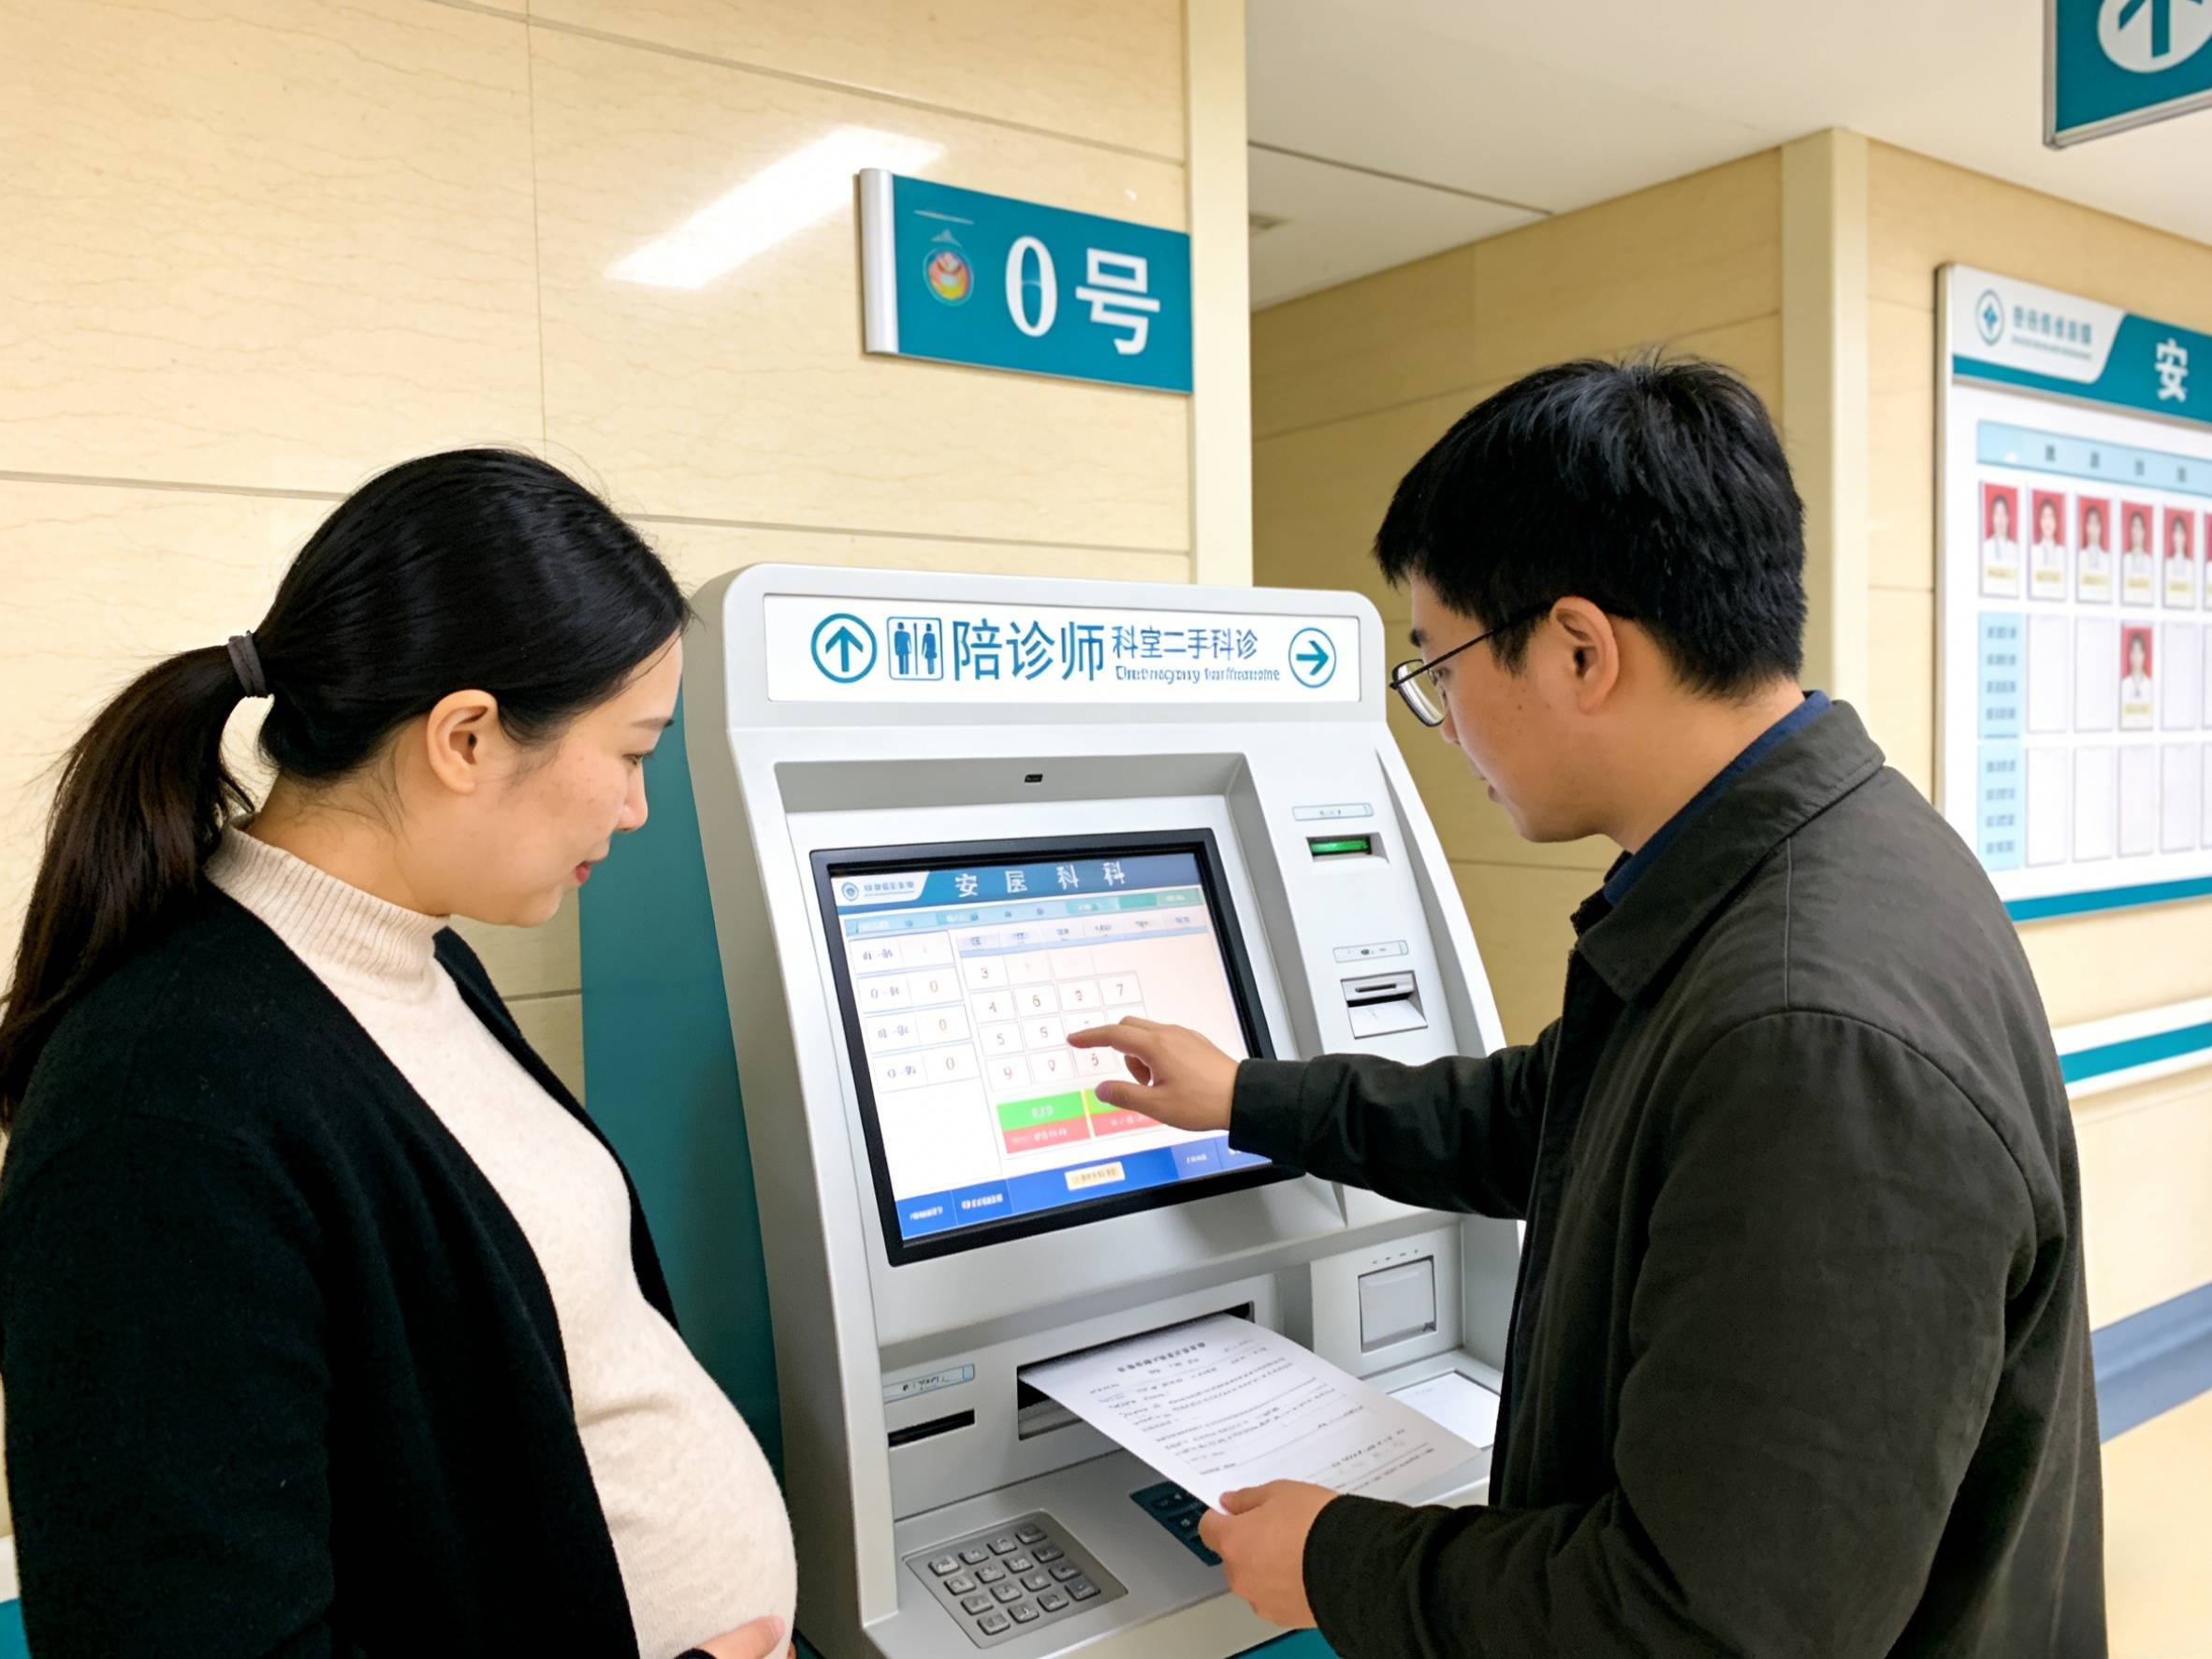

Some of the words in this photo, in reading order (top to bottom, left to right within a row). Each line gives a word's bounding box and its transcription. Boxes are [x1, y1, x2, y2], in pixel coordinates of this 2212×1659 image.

[1005, 236, 1160, 356] 0号
[2155, 338, 2189, 403] 安
[953, 618, 1105, 681] 陪诊师
